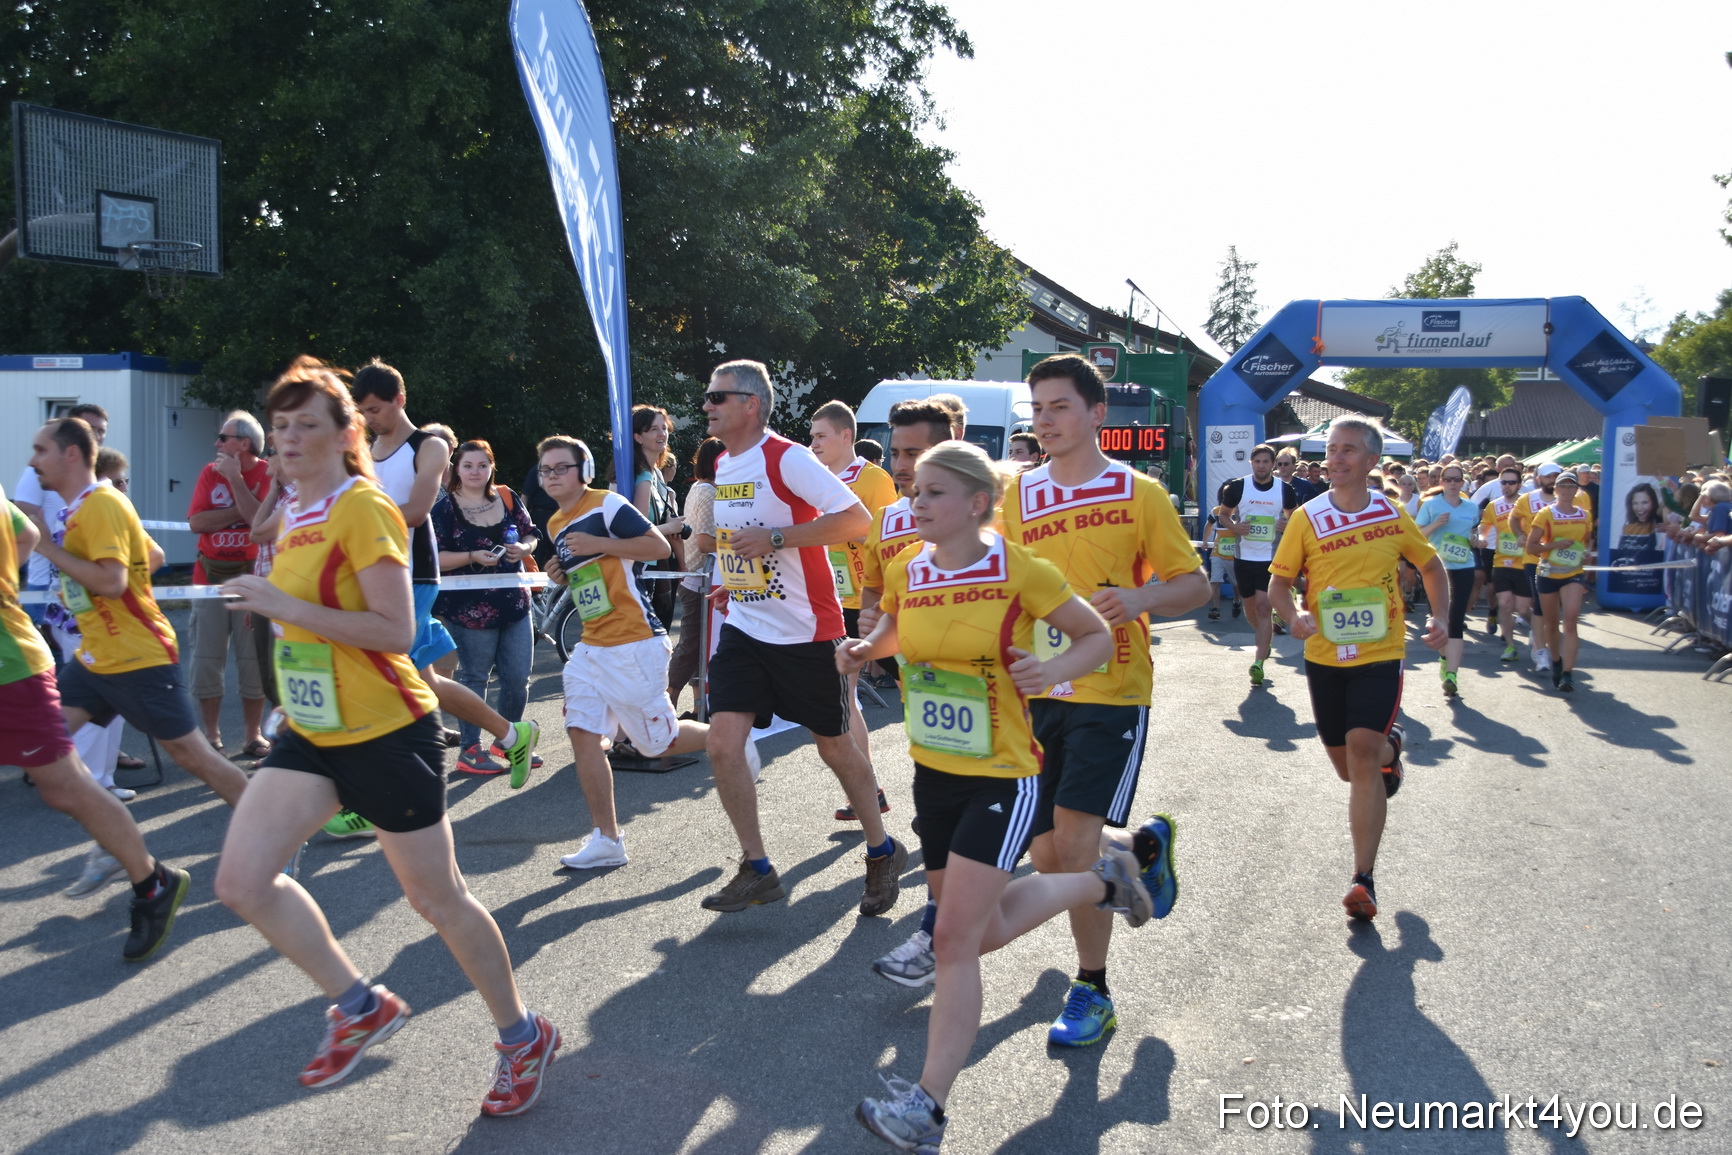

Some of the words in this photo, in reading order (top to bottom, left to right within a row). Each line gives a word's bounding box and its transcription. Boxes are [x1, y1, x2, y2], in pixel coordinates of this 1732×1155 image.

[1408, 332, 1492, 348] firmenlauf
[1250, 361, 1294, 371] Fischer
[728, 500, 754, 508] Germany
[1022, 518, 1068, 546] MAX
[1074, 508, 1134, 530] BÖGL
[1250, 526, 1268, 534] 593
[288, 530, 327, 550] BÖGL
[1319, 534, 1359, 554] MAX
[1362, 524, 1404, 542] BÖGL
[1442, 543, 1467, 558] 1425
[1556, 548, 1576, 560] 896
[720, 552, 755, 574] 1021
[578, 586, 600, 606] 454
[903, 594, 946, 610] MAX
[952, 587, 1009, 605] BÖGL
[1333, 610, 1374, 630] 949
[288, 677, 324, 708] 926
[922, 700, 973, 733] 890
